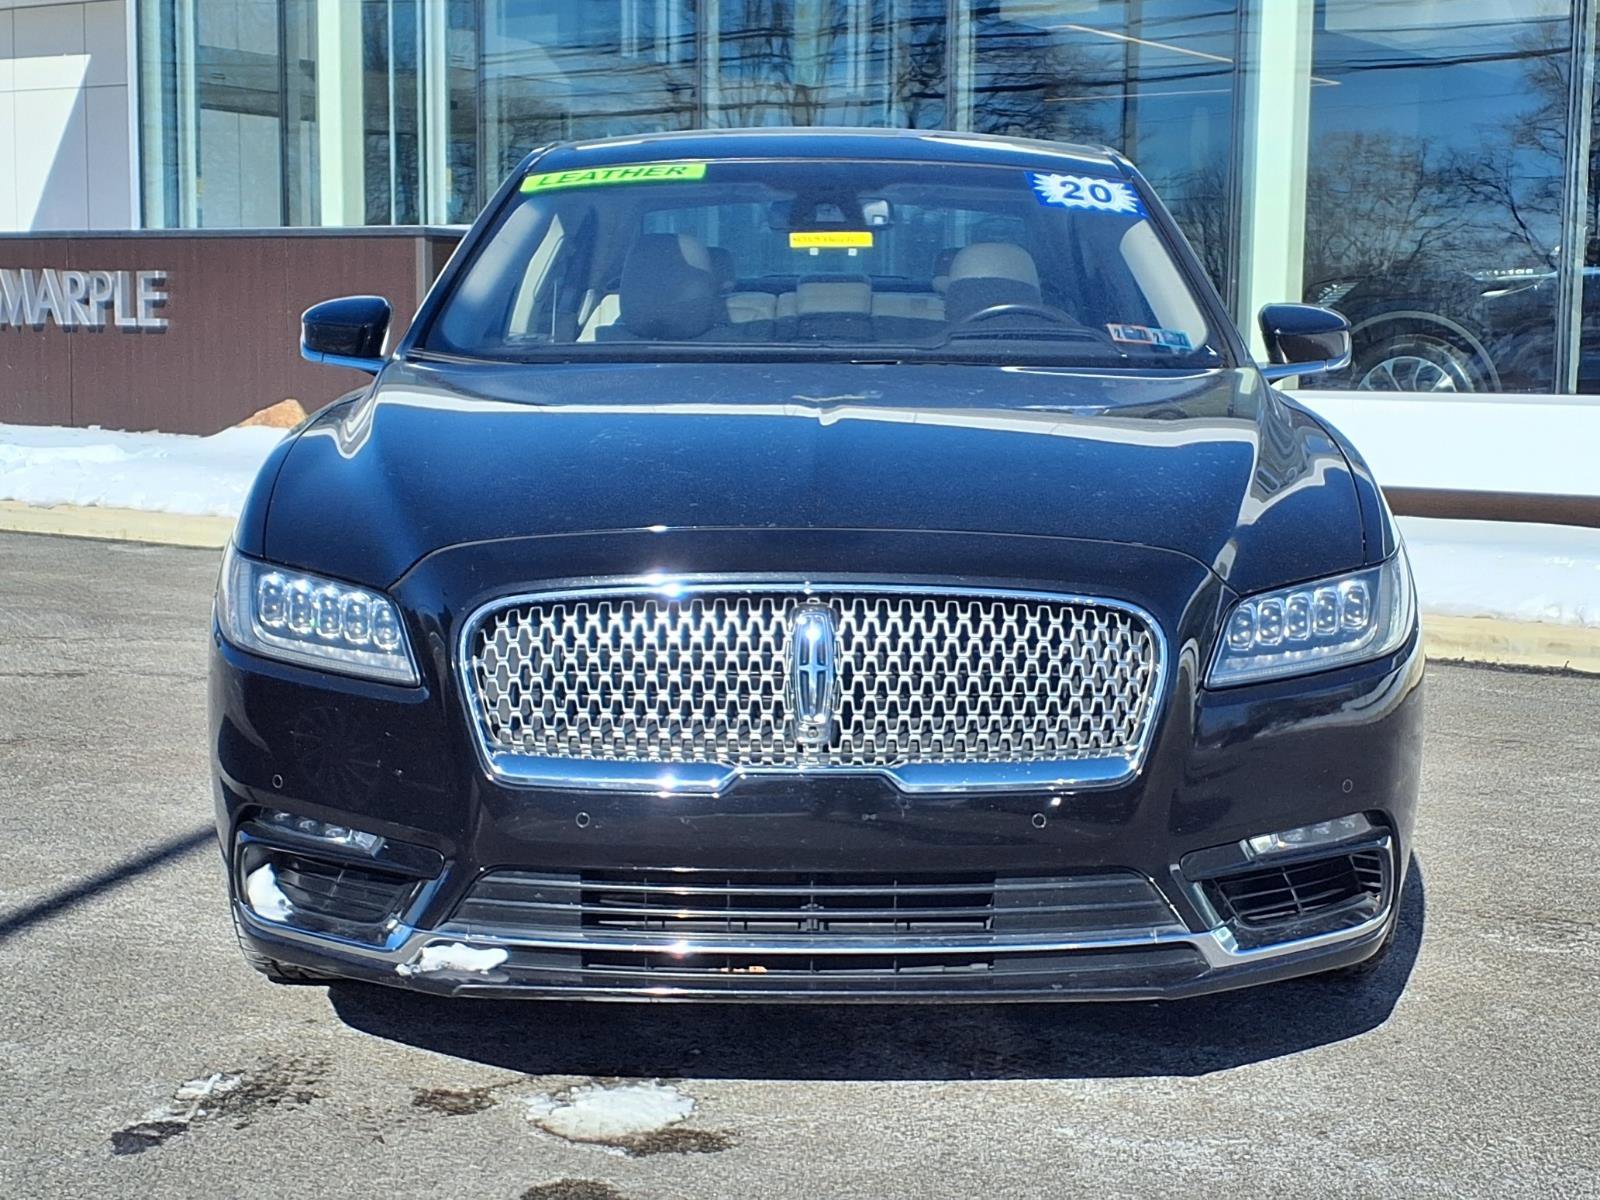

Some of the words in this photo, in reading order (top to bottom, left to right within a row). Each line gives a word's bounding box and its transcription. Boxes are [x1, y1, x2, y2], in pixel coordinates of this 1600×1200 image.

[538, 166, 688, 187] LEATHER
[1059, 180, 1113, 204] 20
[0, 268, 169, 327] MARPLE
